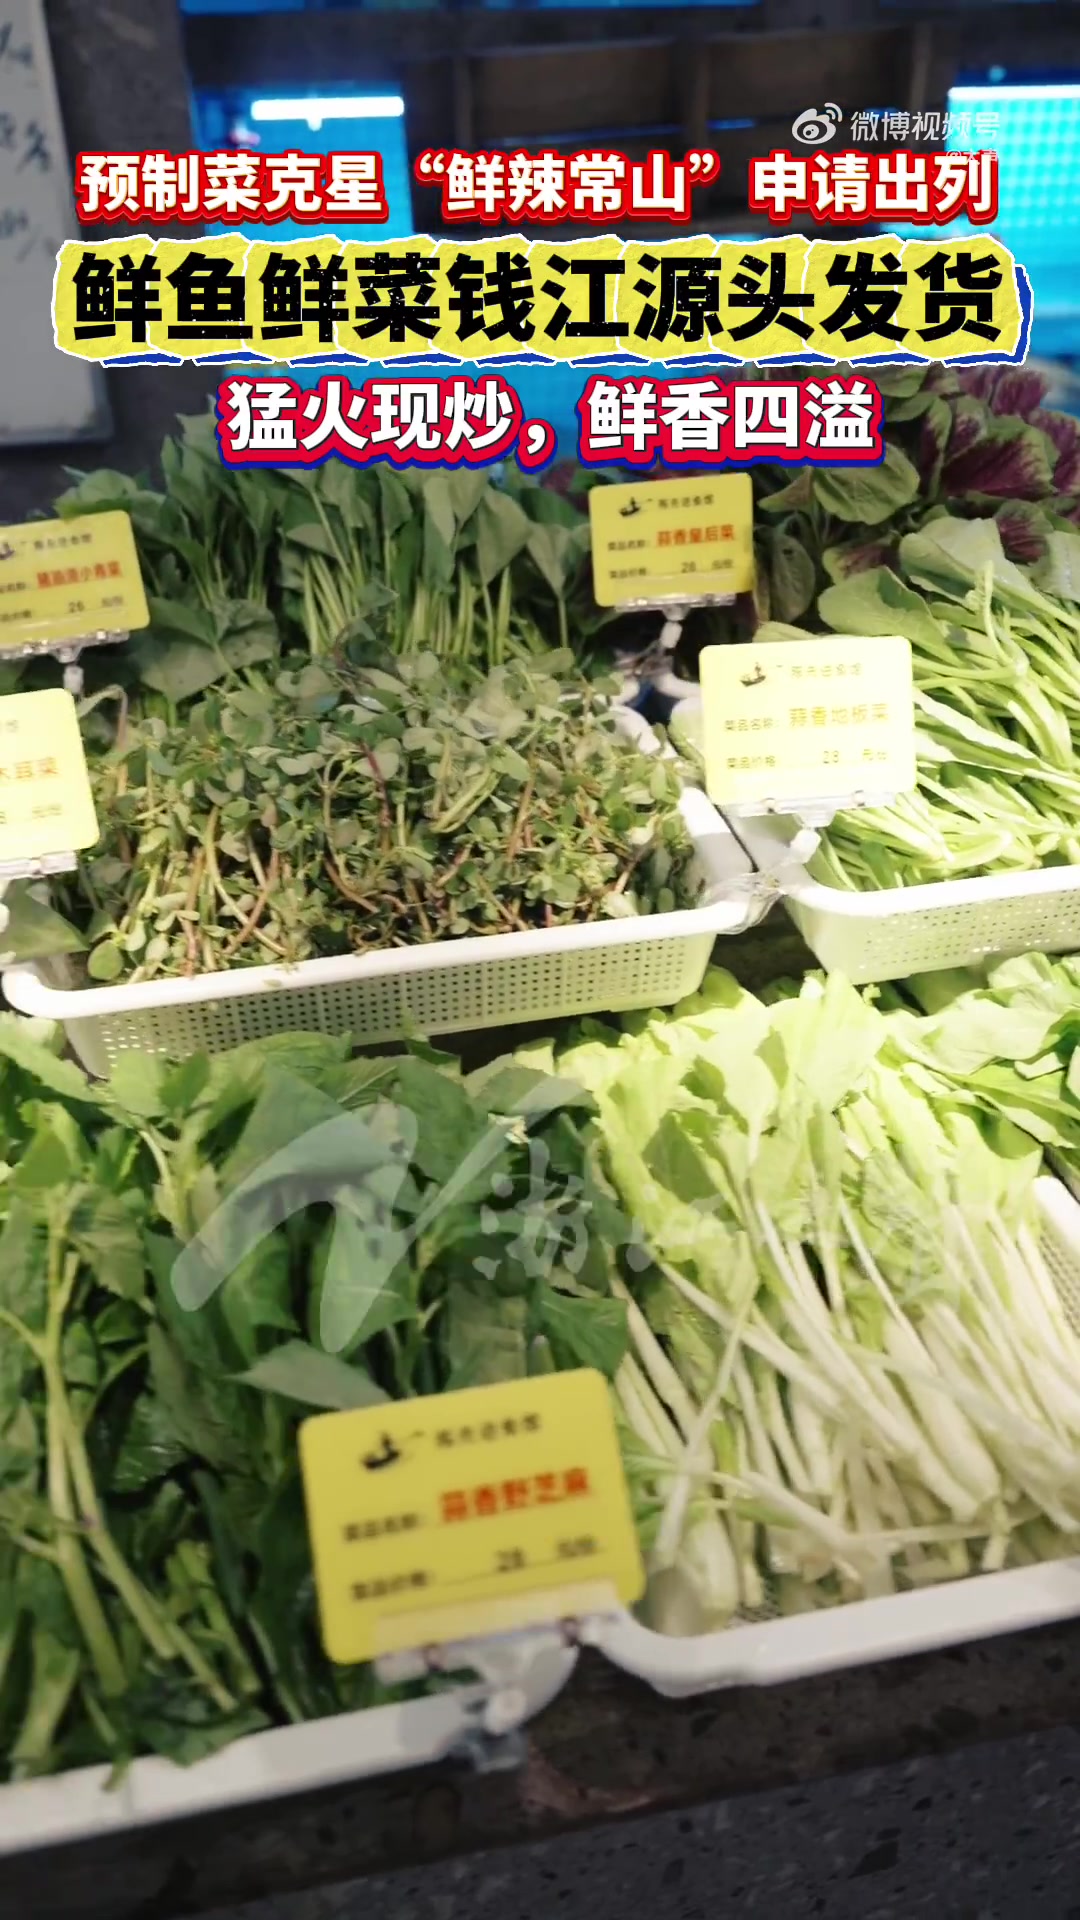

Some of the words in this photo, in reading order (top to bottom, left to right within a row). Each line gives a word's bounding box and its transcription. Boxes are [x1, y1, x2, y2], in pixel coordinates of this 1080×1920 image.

[441, 1466, 589, 1523] 蒜香野芝麻
